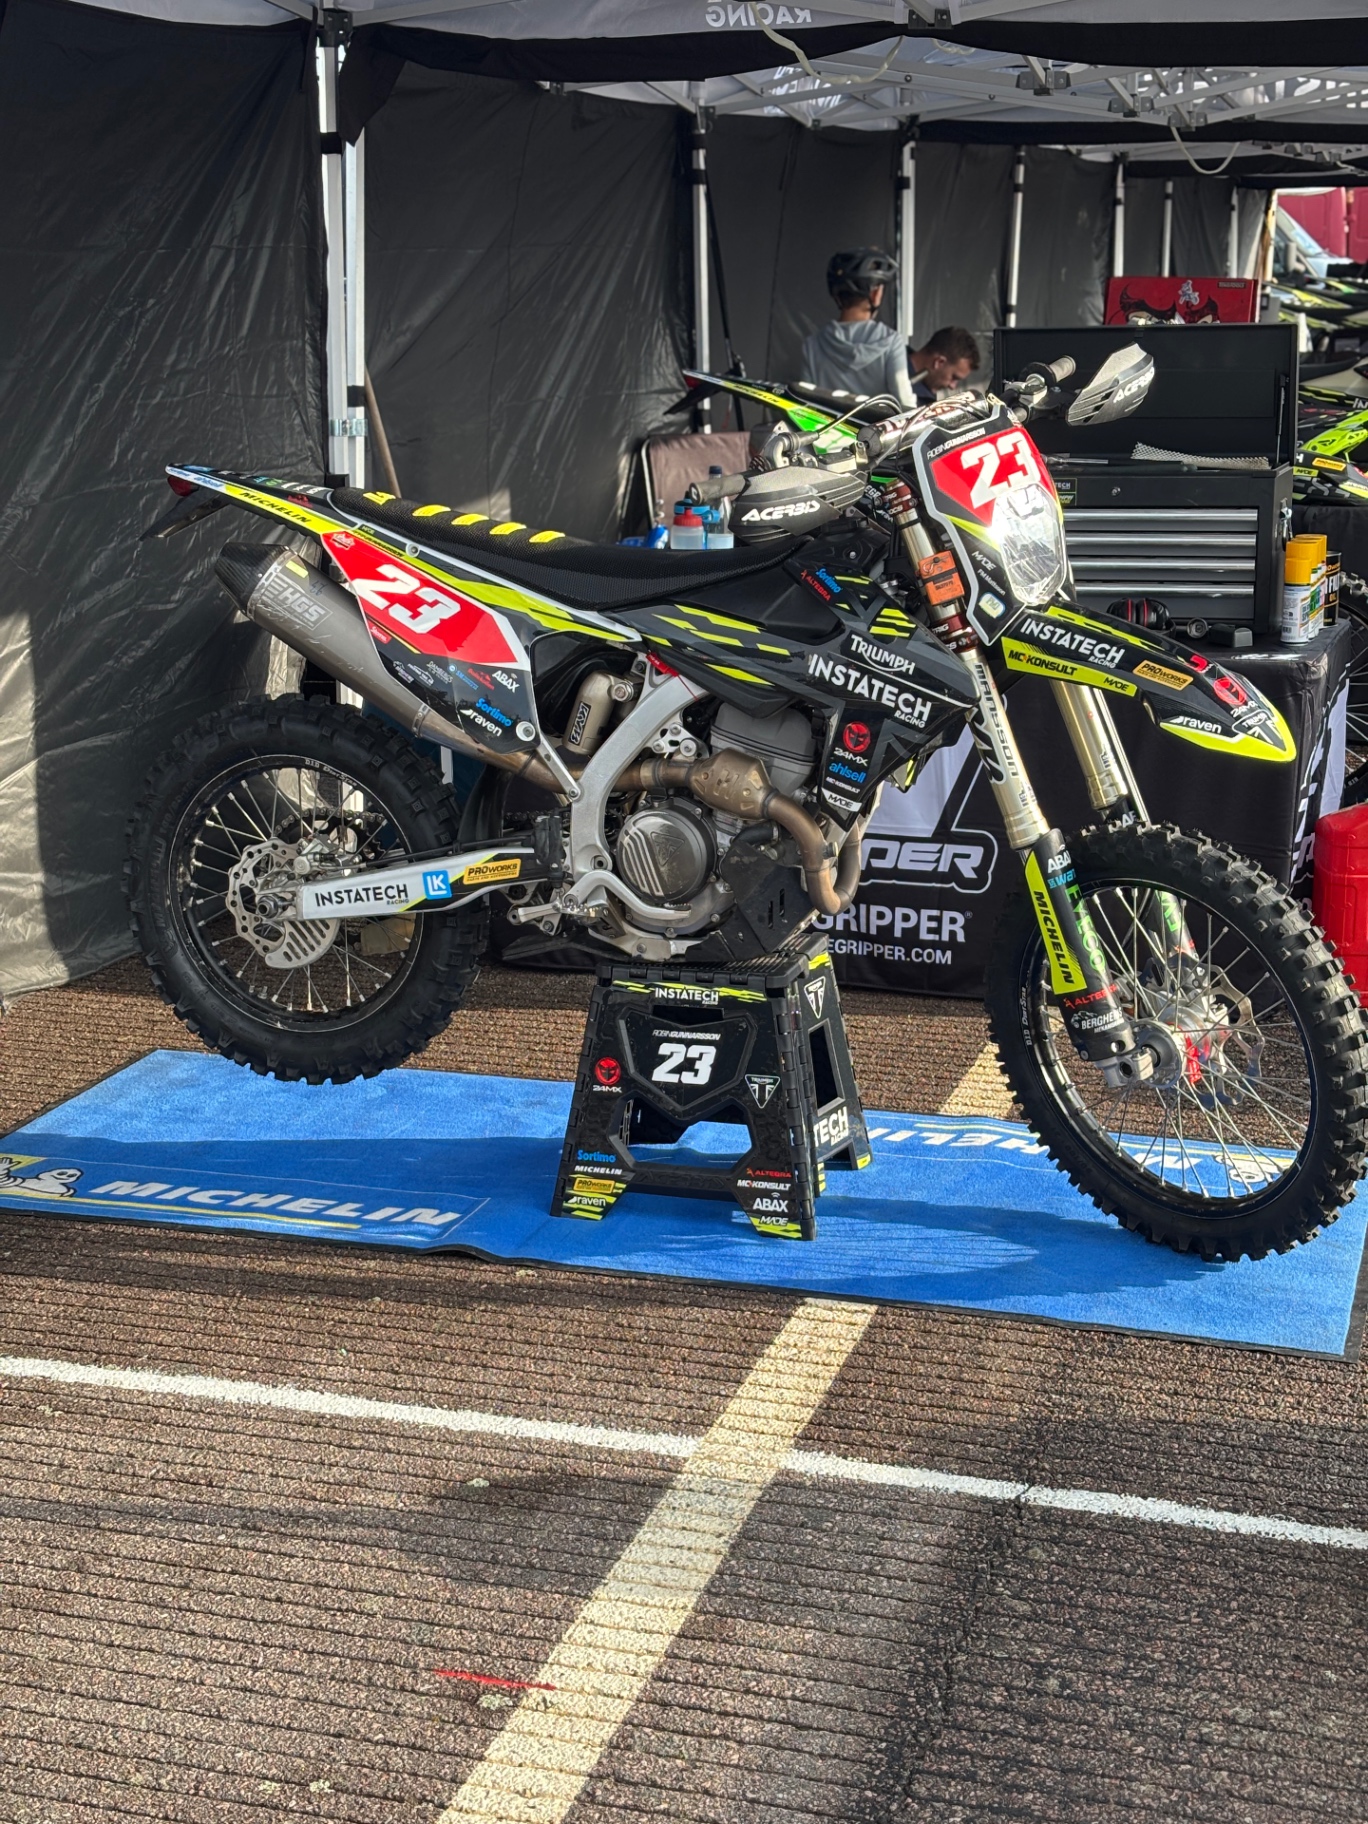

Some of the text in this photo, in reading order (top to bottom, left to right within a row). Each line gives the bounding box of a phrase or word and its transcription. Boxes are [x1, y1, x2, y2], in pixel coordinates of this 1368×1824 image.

[960, 431, 1042, 510] 23
[240, 491, 312, 524] MICHELIN
[741, 500, 821, 521] ACERBIS
[815, 568, 842, 594] Sortimo
[278, 587, 326, 622] HGS
[350, 563, 461, 634] 23
[1020, 618, 1126, 664] INSTATECH
[851, 634, 916, 675] TRIUMPH
[1088, 656, 1117, 669] RACING
[492, 670, 521, 693] ABAX
[808, 654, 932, 721] INSTATECH
[470, 709, 503, 737] raven
[476, 698, 513, 728] Sortimo
[894, 711, 926, 728] RACING
[1183, 716, 1222, 734] raven
[833, 747, 869, 767] 24MX
[829, 762, 867, 784] ahlsell
[828, 793, 854, 808] MADE
[861, 838, 984, 879] PER
[315, 884, 409, 907] INSTATECH
[812, 903, 966, 943] GRIPPER
[1033, 891, 1075, 985] MICHELIN
[827, 938, 953, 965] EGRIPPER.COM
[655, 987, 719, 1002] INSTATECH
[652, 1043, 717, 1085] 23
[592, 1084, 623, 1094] 24MX
[577, 1149, 617, 1163] Sortimo
[574, 1165, 623, 1175] MICHELIN
[88, 1180, 464, 1225] MICHELIN
[577, 1196, 606, 1206] raven
[752, 1197, 789, 1213] ABAX
[759, 1215, 789, 1226] MADE
